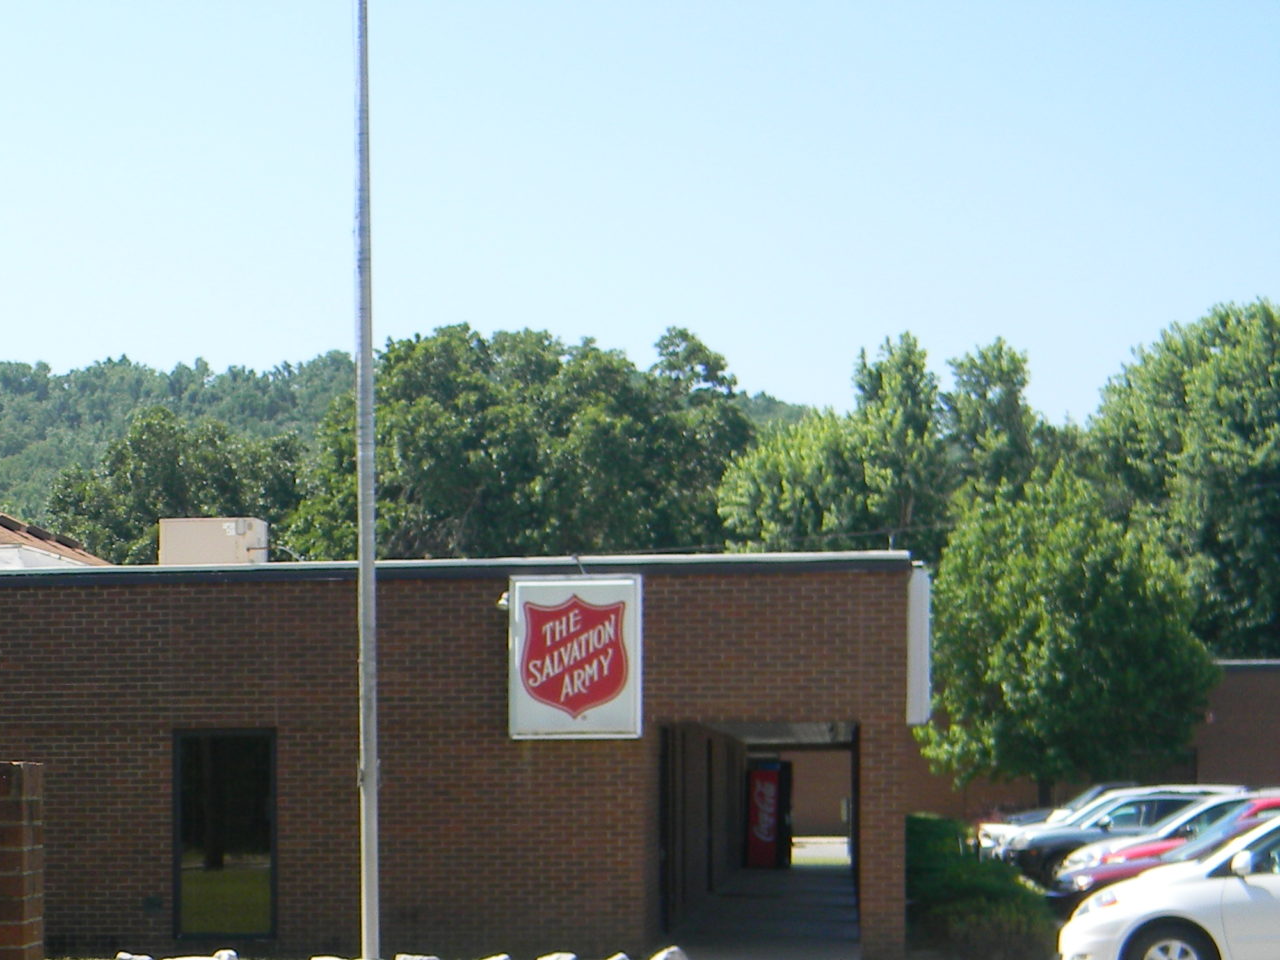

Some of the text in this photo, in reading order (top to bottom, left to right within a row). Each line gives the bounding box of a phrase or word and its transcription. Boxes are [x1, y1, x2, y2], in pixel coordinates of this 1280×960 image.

[528, 613, 617, 688] SALVATION
[542, 609, 583, 648] THE
[559, 647, 613, 703] ARMY
